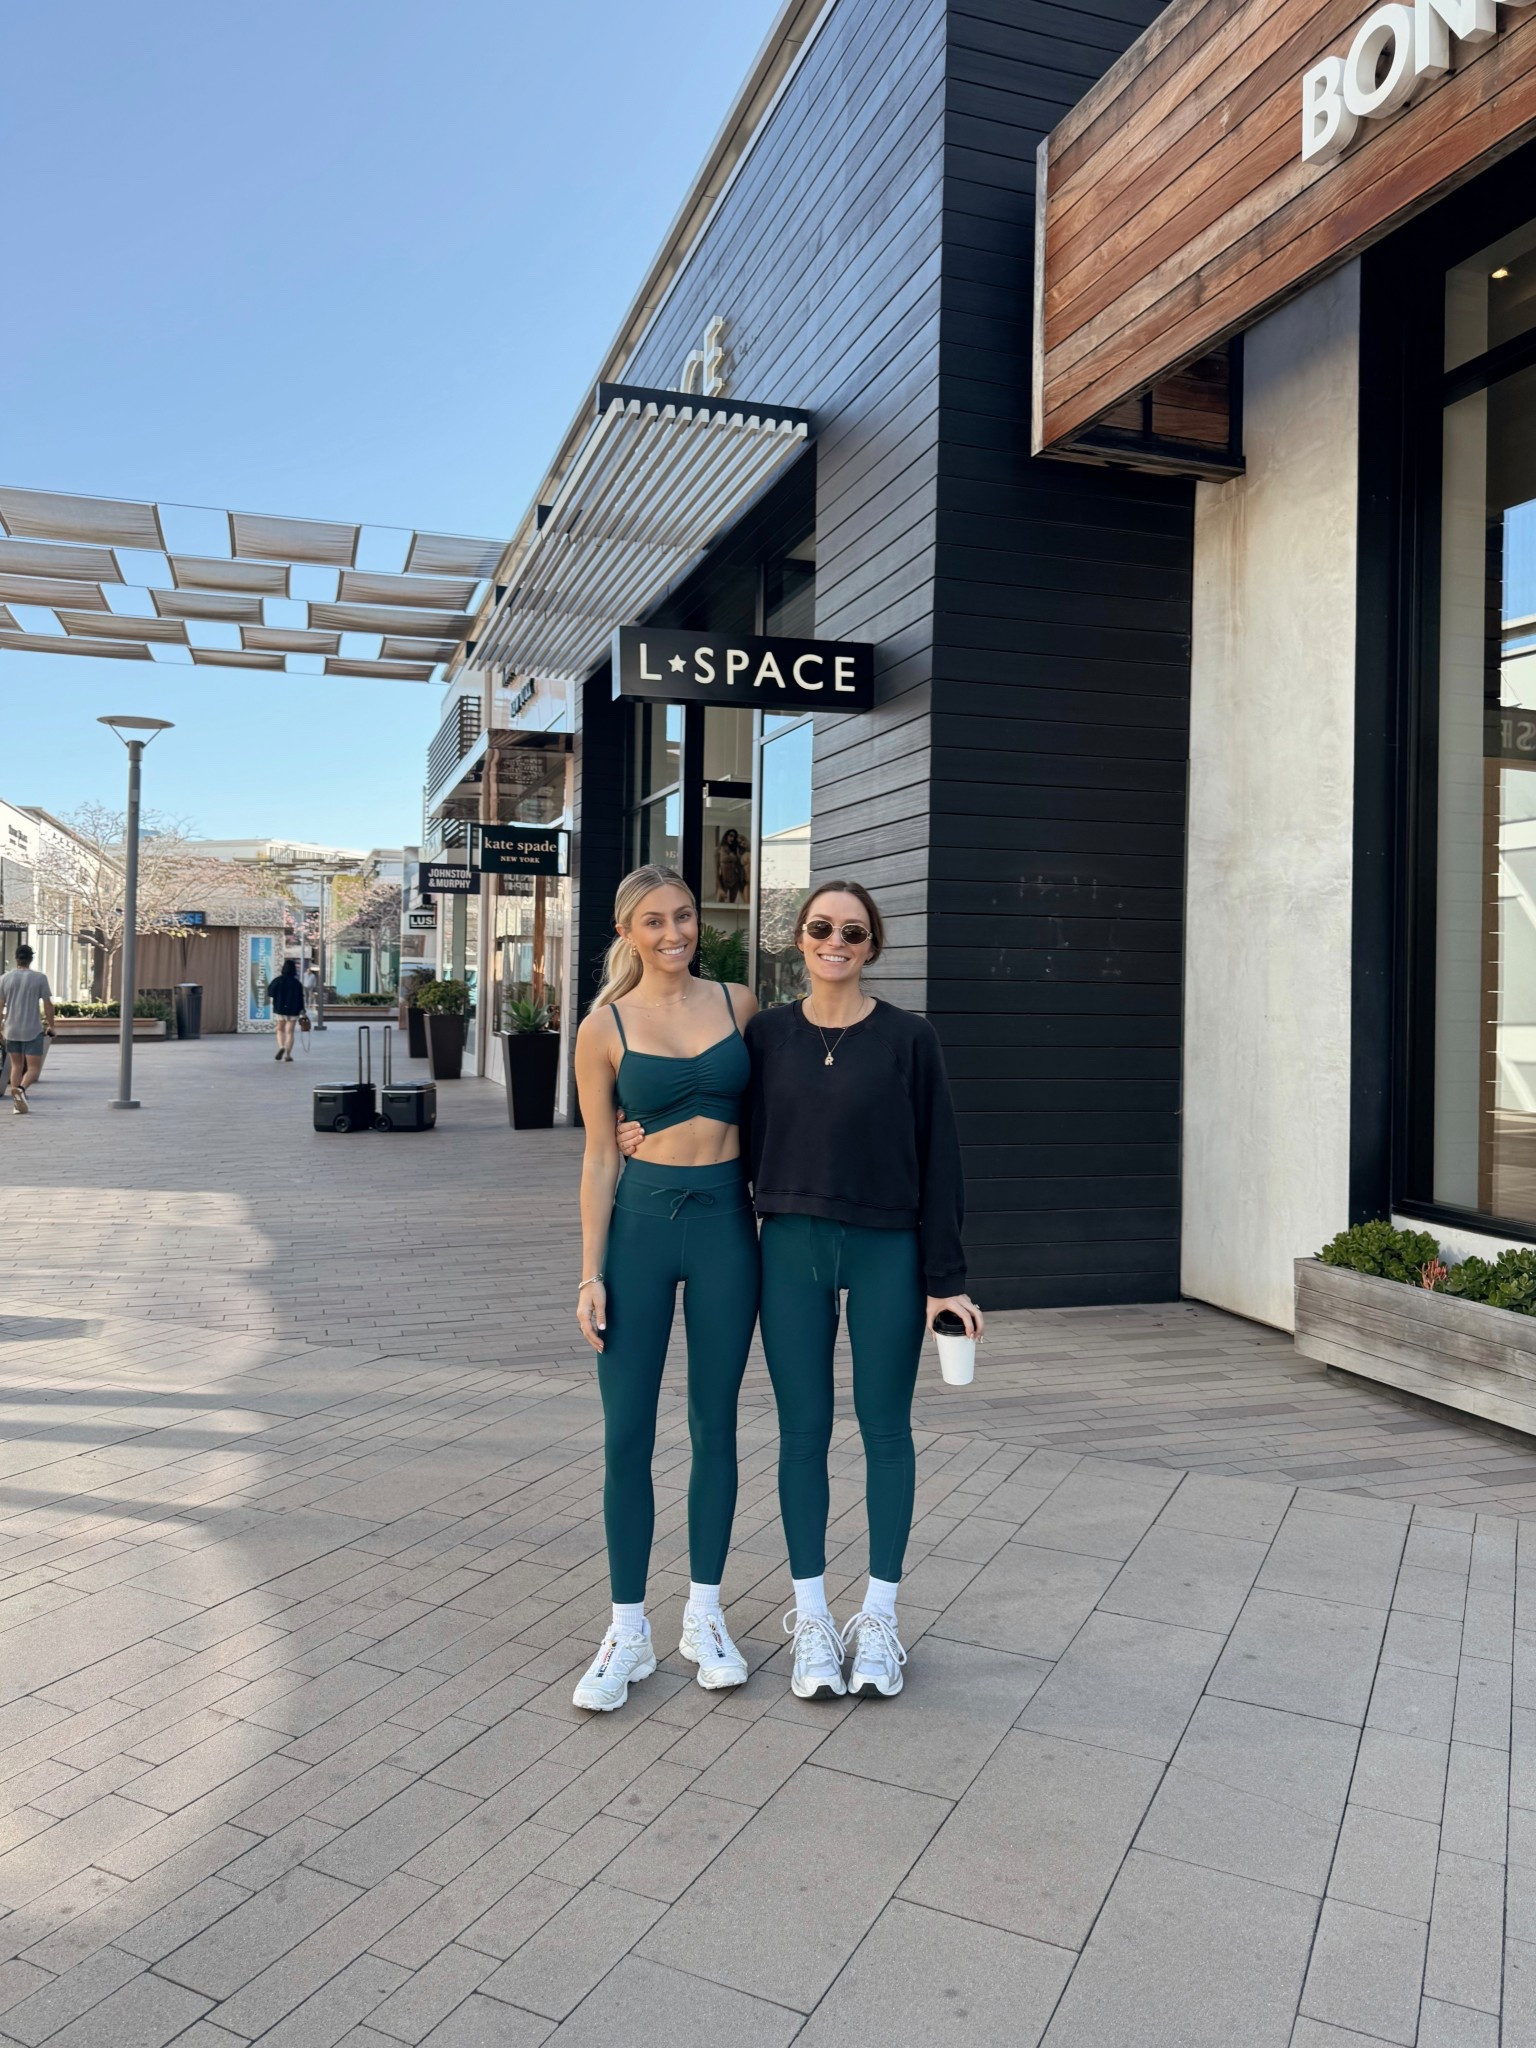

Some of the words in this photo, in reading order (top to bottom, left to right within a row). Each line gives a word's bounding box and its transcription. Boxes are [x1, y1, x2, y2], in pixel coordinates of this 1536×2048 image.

[1302, 0, 1536, 162] BON
[484, 836, 514, 850] kate
[517, 840, 557, 854] spade
[519, 856, 540, 864] YORK
[428, 868, 472, 879] JOHNSTON
